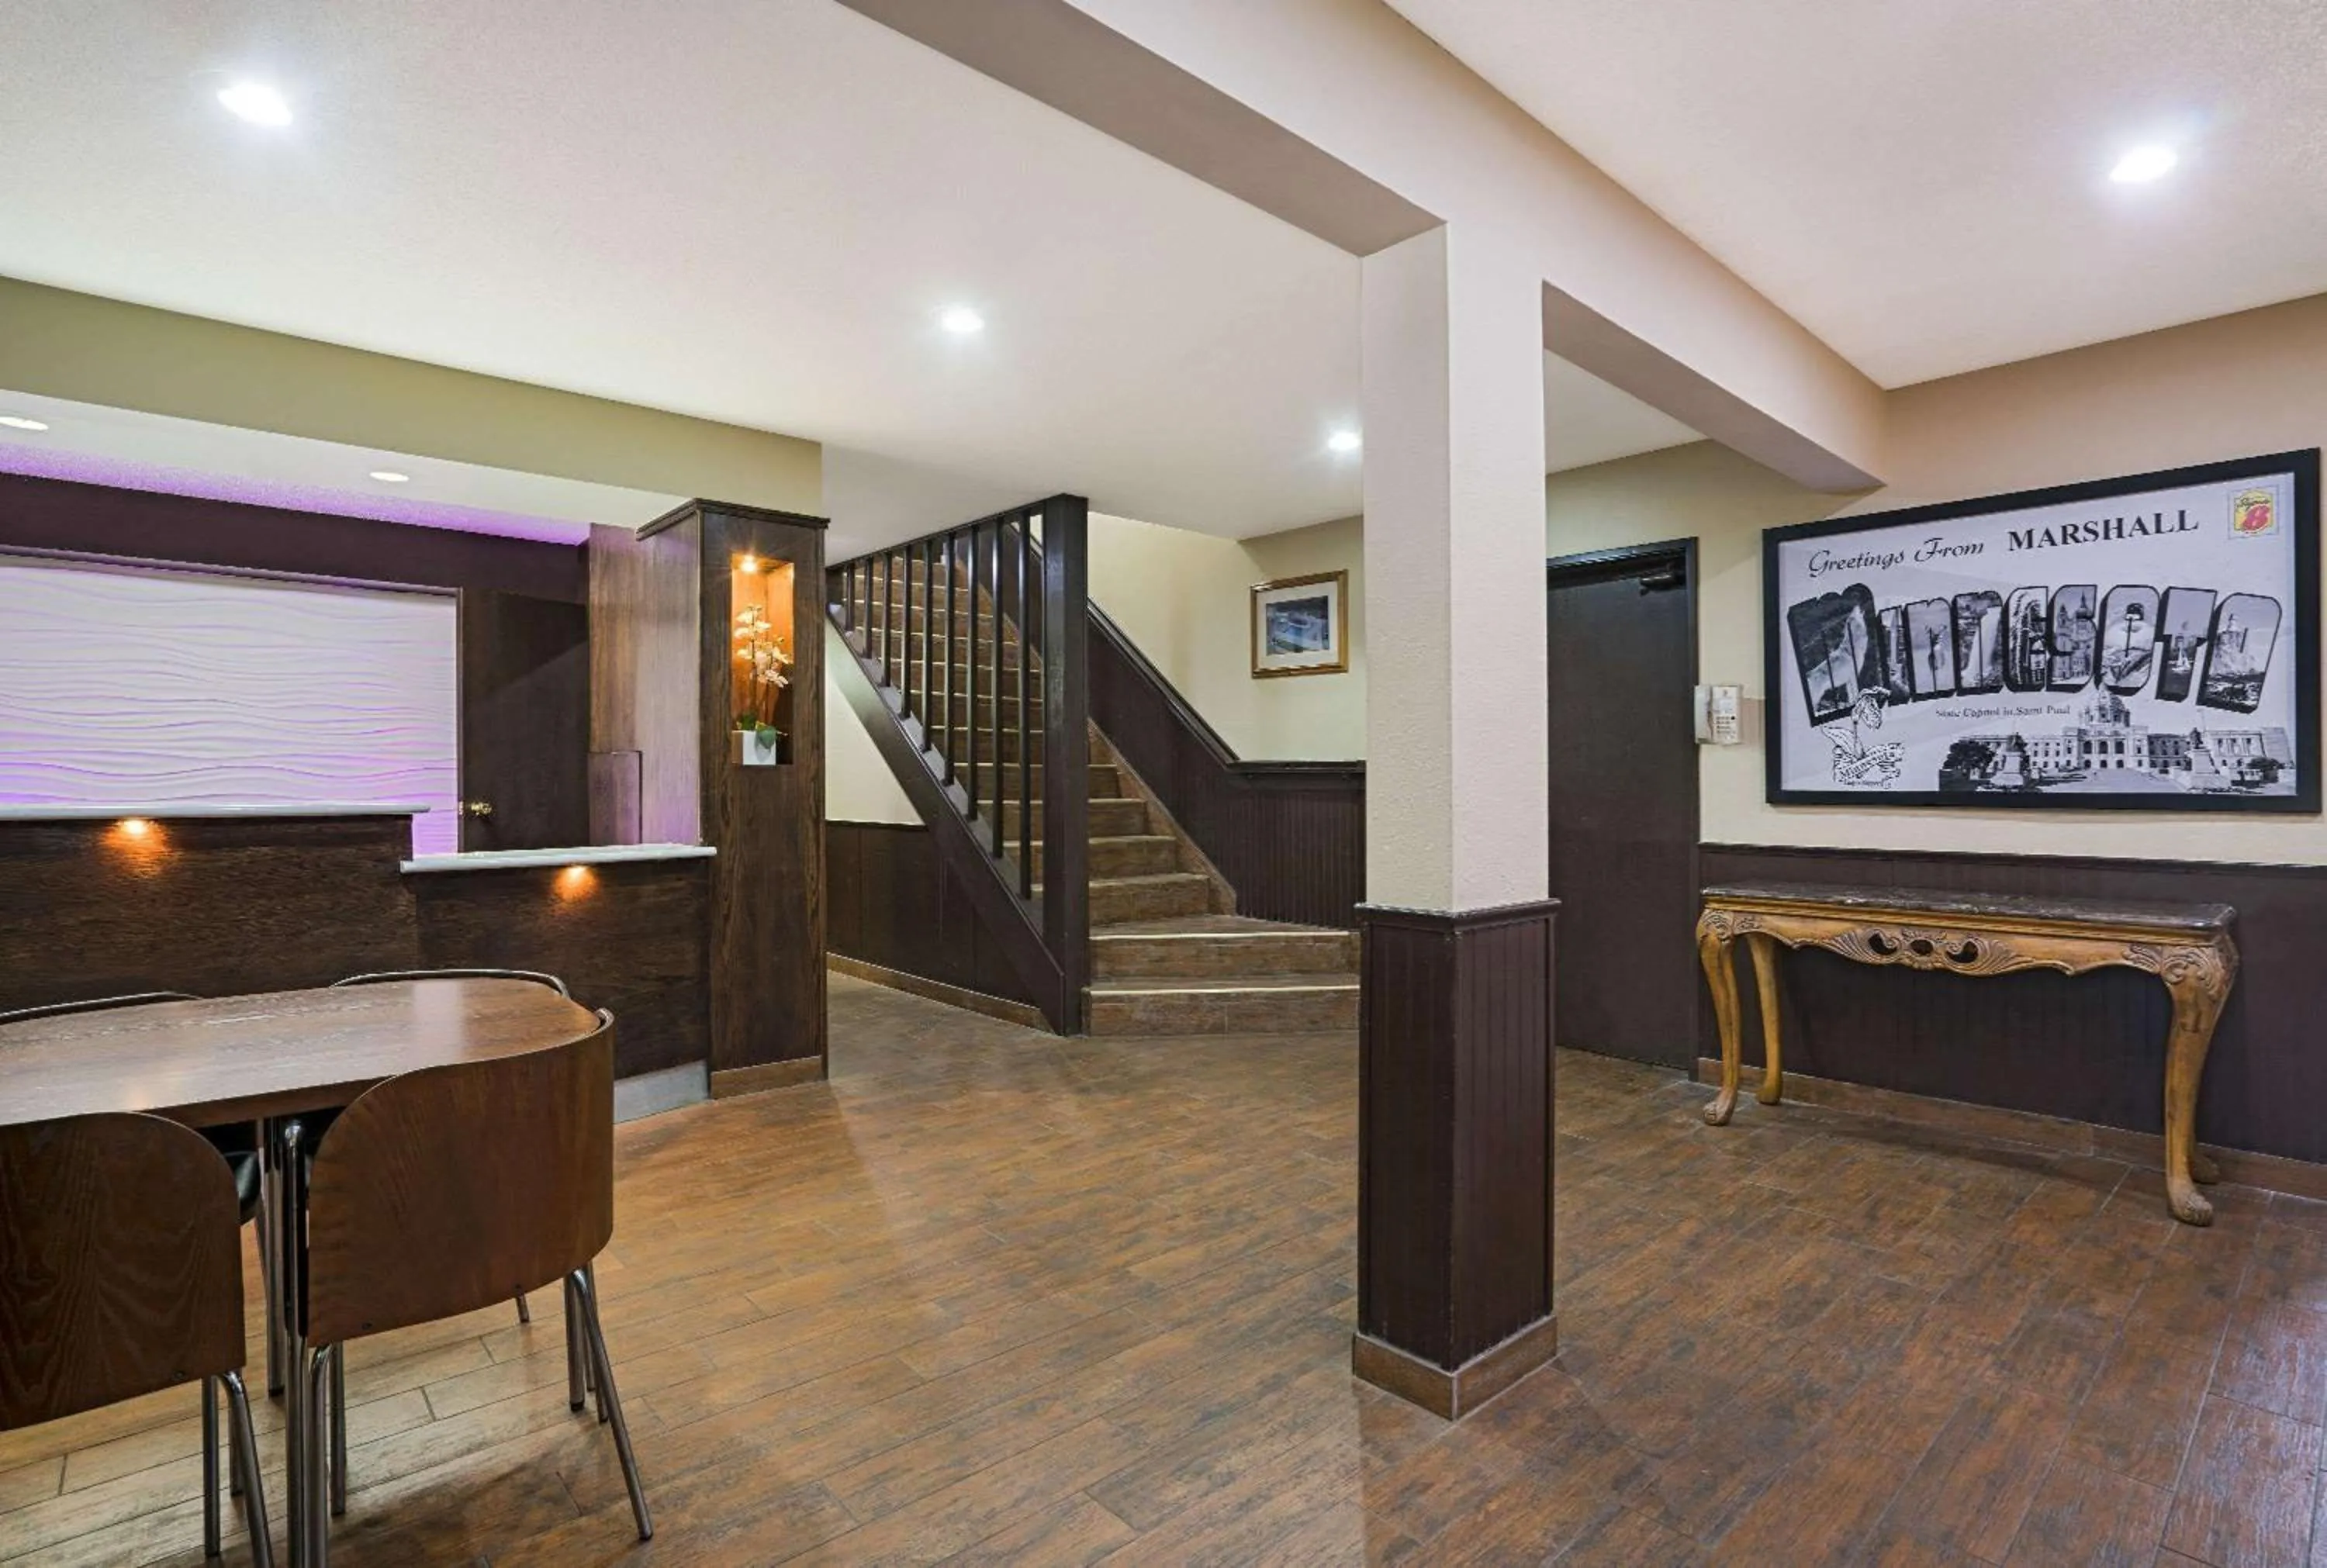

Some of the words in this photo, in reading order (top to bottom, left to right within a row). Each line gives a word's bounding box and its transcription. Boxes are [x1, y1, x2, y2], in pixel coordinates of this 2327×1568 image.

[1808, 549, 1904, 578] Greetings
[1914, 537, 1984, 562] From
[2007, 509, 2200, 551] MARSHALL
[2016, 706, 2043, 716] Saint
[2046, 704, 2071, 714] Paul
